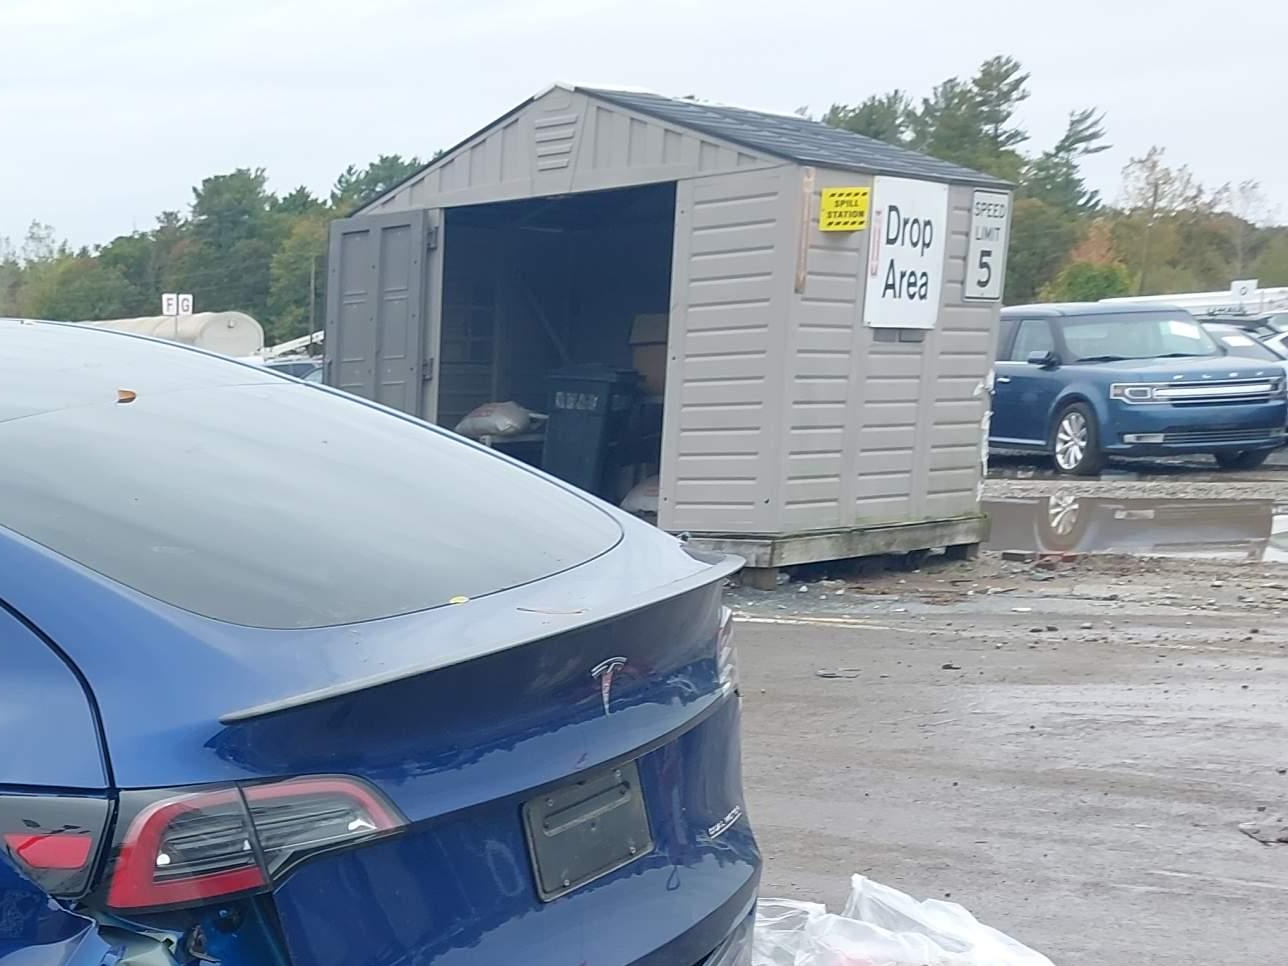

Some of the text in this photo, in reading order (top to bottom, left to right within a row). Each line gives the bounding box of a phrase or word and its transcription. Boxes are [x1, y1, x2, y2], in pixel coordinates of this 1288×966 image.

[834, 199, 859, 207] SPILL
[973, 201, 1006, 219] SPEED
[827, 210, 865, 218] STATION
[886, 205, 933, 257] Drop
[975, 225, 1001, 241] LIMIT
[976, 250, 993, 288] 5
[881, 258, 929, 301] Area
[167, 298, 174, 312] F
[181, 298, 190, 312] G
